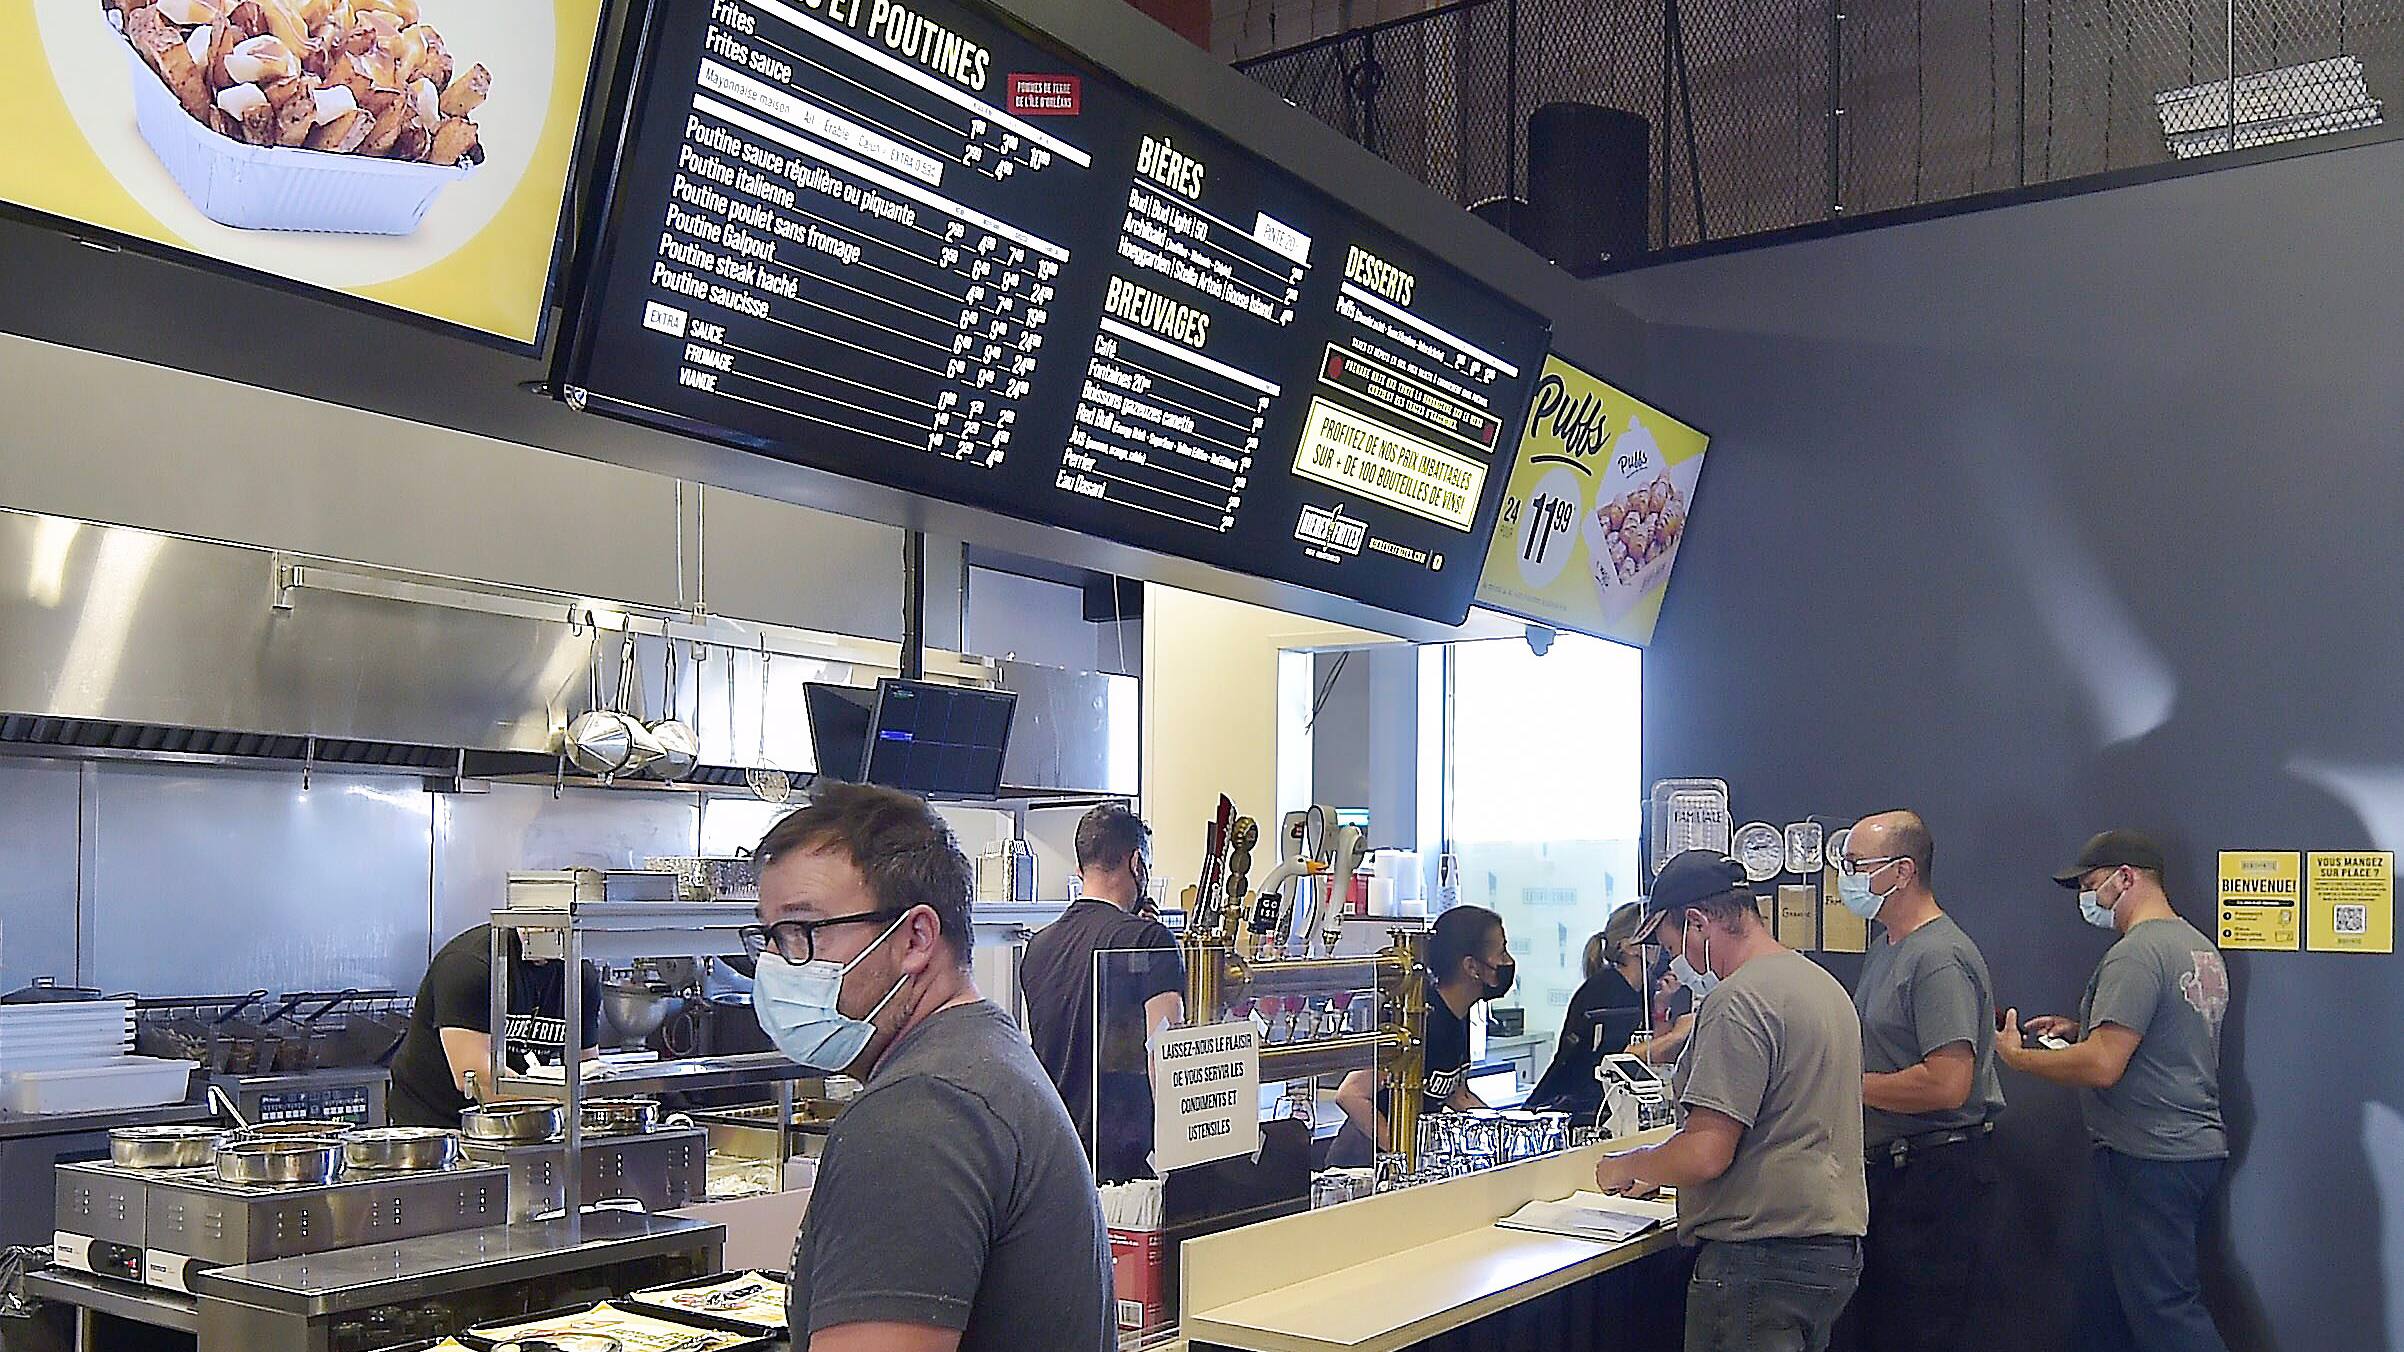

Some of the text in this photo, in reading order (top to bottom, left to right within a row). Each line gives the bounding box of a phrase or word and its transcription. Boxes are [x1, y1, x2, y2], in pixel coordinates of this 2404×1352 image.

[712, 0, 756, 36] Frites
[706, 24, 792, 84] Frites sauce
[867, 0, 990, 91] POUTINES
[706, 67, 758, 101] Mayonnaise
[760, 93, 791, 114] maison
[678, 144, 795, 210] Poutine italienne
[685, 115, 916, 227] Poutine sauce régulière ou piquante
[1137, 134, 1205, 200] BIÈRES
[665, 203, 776, 263] Poutine Galpout
[672, 174, 861, 266] Poutine poulet sans fromage
[658, 232, 799, 300] Poutine steak haché
[1345, 245, 1415, 306] DESSERTS
[652, 262, 770, 319] Poutine saucisse
[650, 309, 680, 329] EXTRA
[1104, 275, 1210, 348] BREUVAGES
[690, 319, 726, 344] SAUCE
[1095, 334, 1118, 359] Café
[684, 342, 735, 373] FROMAGE
[680, 366, 718, 392] VIANDE
[1531, 373, 1611, 459] Puffs
[1069, 424, 1087, 447] Jus
[1062, 447, 1097, 472] Perrier
[1320, 416, 1473, 491] PROFITEZ DE NOS PRIX IMBATTABLES
[1617, 450, 1648, 474] Puffs
[1056, 468, 1076, 491] Eau
[1312, 443, 1335, 469] SUR
[1343, 454, 1359, 478] DE
[1359, 460, 1376, 484] 100
[1376, 466, 1431, 503] BOUTEILLES
[1428, 485, 1443, 507] DE
[1503, 496, 1521, 525] 24
[2317, 857, 2383, 867] VOUS MANGEZ
[2320, 868, 2339, 877] SUR
[2341, 868, 2370, 878] PLACE
[2222, 878, 2297, 893] BIENVENUE!
[1162, 1033, 1252, 1060] LAISSEZ-NOUS LE PLAISIR
[1173, 1061, 1244, 1088] DE VOUS SERVIR LES
[1181, 1089, 1238, 1115] CONDIMENTS ET
[1188, 1118, 1231, 1142] USTENSILES
